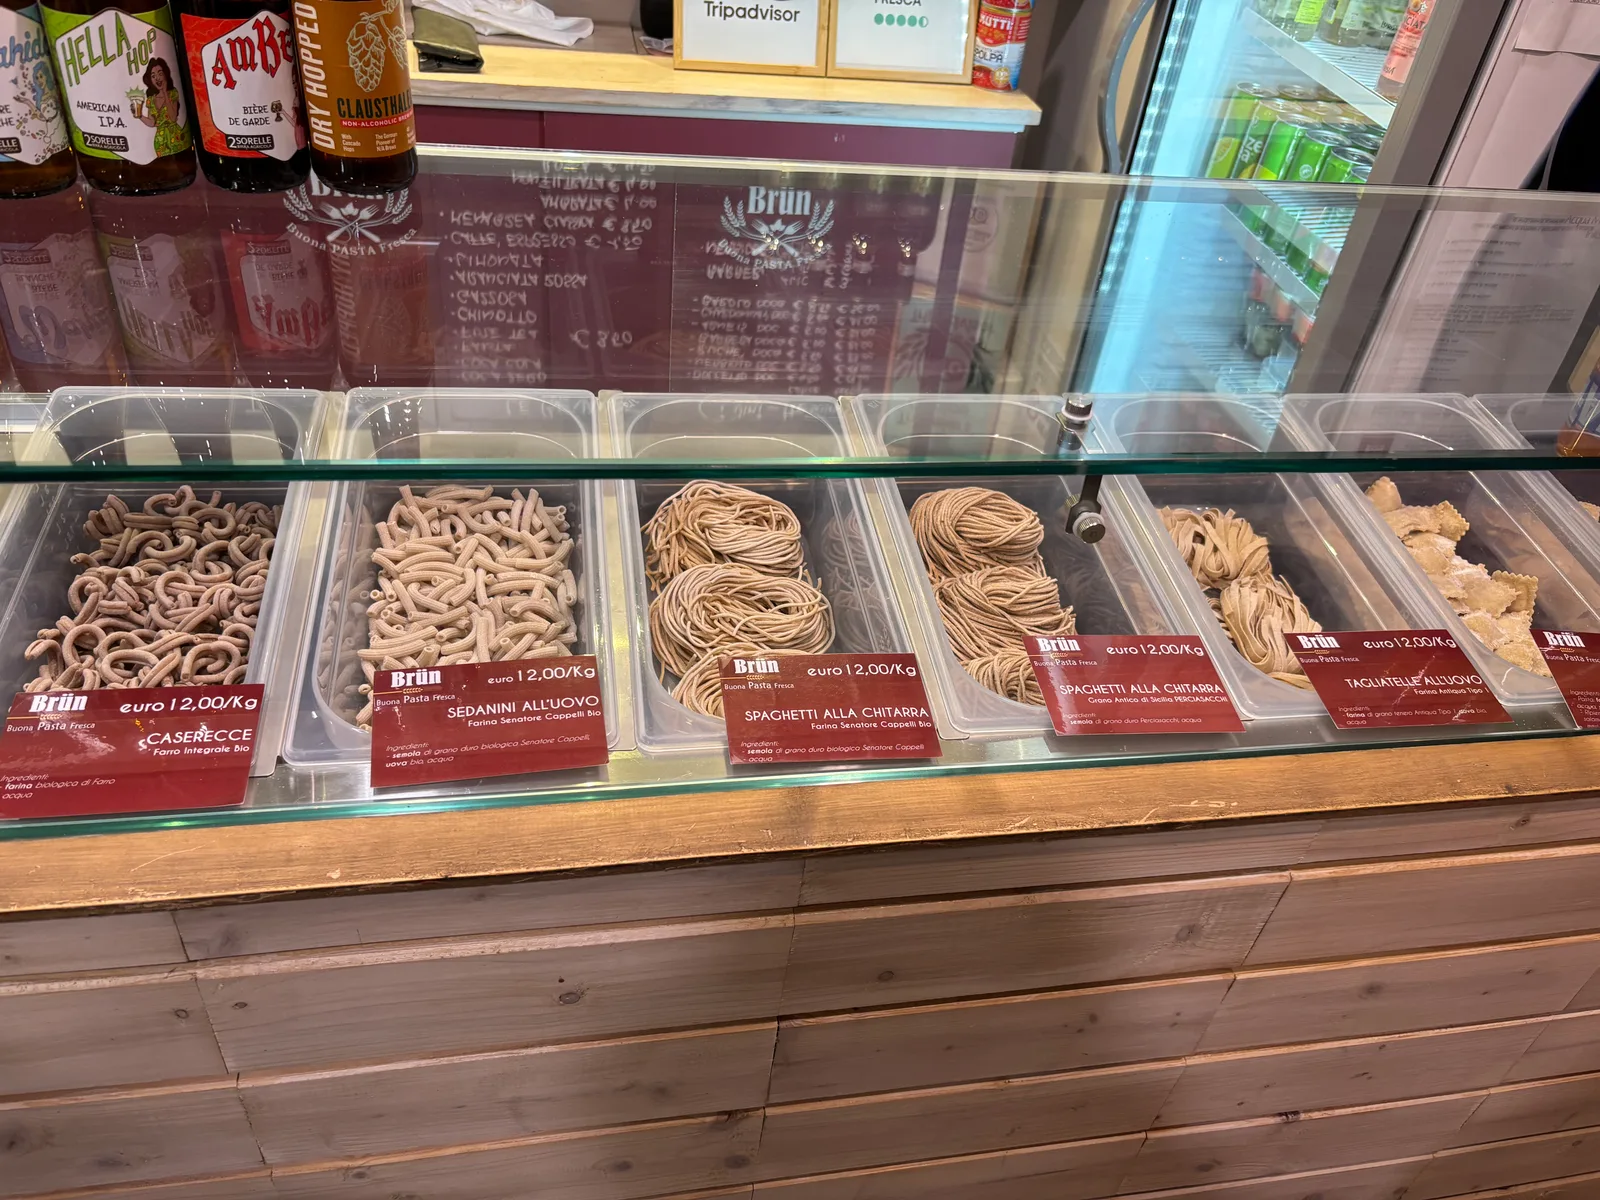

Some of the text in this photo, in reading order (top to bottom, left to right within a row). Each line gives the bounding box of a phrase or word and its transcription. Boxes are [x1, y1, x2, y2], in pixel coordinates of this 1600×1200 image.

[703, 1, 801, 22] Tripadvisor
[61, 12, 131, 87] HELLA
[126, 27, 157, 76] HOP
[294, 1, 335, 149] DRY HOPPED
[76, 100, 120, 113] AMERICAN
[243, 103, 269, 115] BIÈRE
[228, 117, 271, 126] DE GARDE
[342, 117, 397, 127] NON-ALCOHOLIC
[747, 185, 812, 216] Brün
[286, 221, 417, 256] Buona PASTA Fresca
[717, 238, 751, 265] Buona
[754, 258, 792, 270] PASTA
[1036, 637, 1081, 652] Brün
[1296, 634, 1340, 648] Brün
[1363, 636, 1457, 649] euro 12,00/Kg
[1542, 631, 1586, 648] Brün
[1106, 644, 1204, 657] euro 12,00/Kg
[1563, 653, 1585, 662] Pasta
[733, 658, 780, 674] Brün
[1318, 655, 1340, 663] Pasta
[487, 665, 595, 684] euro 12,00/Kg
[807, 663, 917, 677] euro 12,00/Kg
[390, 669, 441, 688] Brün
[748, 681, 772, 689] Pasta
[1344, 675, 1483, 689] TAGLIATELLE ALL'UOVO
[1059, 683, 1224, 695] SPAGHETTI ALLA CHITARRA
[1439, 688, 1467, 696] Antiqua
[1467, 687, 1483, 695] Tipo
[28, 693, 88, 713] Brün
[119, 695, 258, 713] euro 12,00/Kg
[403, 695, 430, 704] Pasta
[1174, 695, 1228, 703] PERCIASACCHI
[447, 695, 599, 719] SEDANINI ALL'UOVO
[745, 707, 929, 721] SPAGHETTI ALLA CHITARRA
[468, 719, 498, 728] Farina
[500, 715, 542, 724] Senatore
[545, 710, 585, 720] Cappelli
[811, 720, 932, 730] Farina Senatore Cappelli Bio
[6, 721, 96, 732] Buona Pasta Fresca
[146, 729, 253, 745] CASERECCE
[153, 744, 250, 756] Farro Integrale Bio
[392, 750, 421, 759] semola
[434, 748, 458, 757] grano
[460, 745, 479, 753] duro
[480, 741, 519, 751] biologica
[520, 738, 555, 746] Senatore
[385, 760, 408, 768] uova
[426, 756, 455, 765] acqua
[35, 780, 79, 789] biologica
[2, 792, 33, 800] acqua
